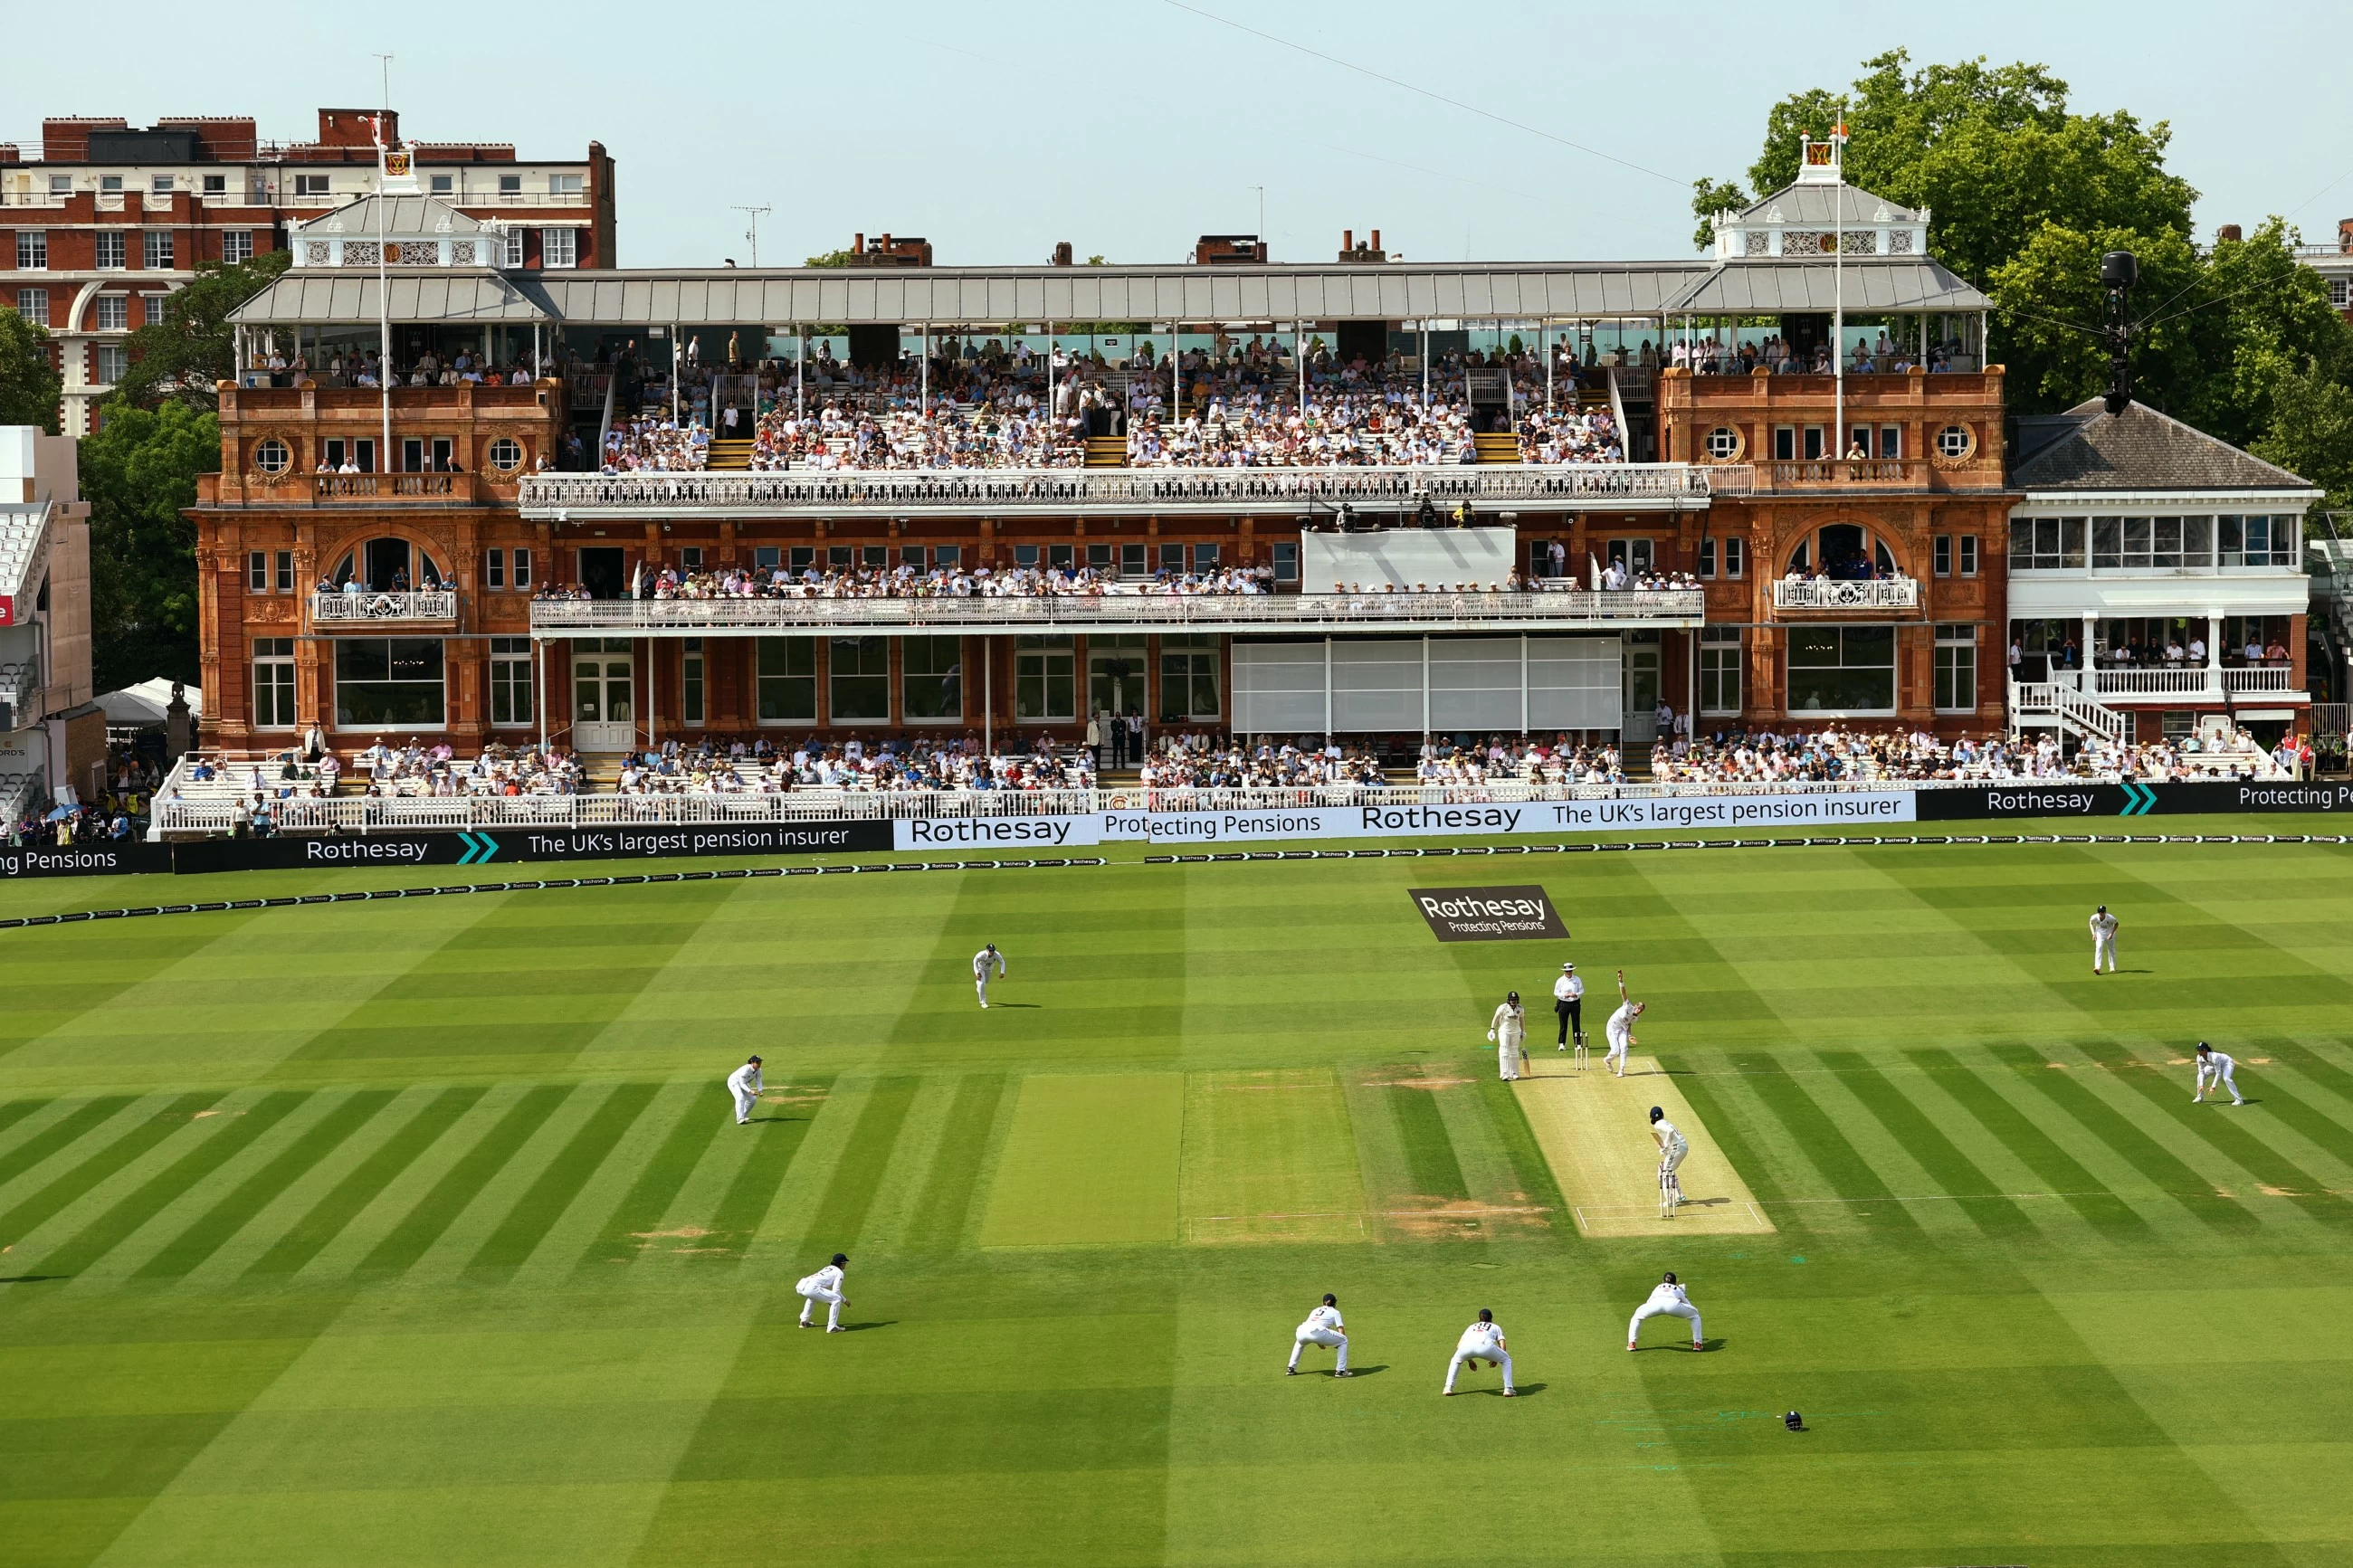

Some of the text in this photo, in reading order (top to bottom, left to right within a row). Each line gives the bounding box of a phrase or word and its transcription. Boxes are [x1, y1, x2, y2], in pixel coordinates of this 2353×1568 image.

[1988, 791, 2094, 813] Rothesay
[2240, 786, 2353, 809] Protecting P
[1363, 803, 1522, 832] Rothesay
[1552, 797, 1901, 825] The UK's largest pension insurer
[911, 818, 1072, 845] Rothesay
[1105, 811, 1321, 840] Protecting Pensions
[307, 840, 428, 863] Rothesay
[529, 827, 849, 854] The UK's largest pension insurer
[26, 850, 117, 870] Pensions
[1419, 896, 1545, 921] Rothesay
[1448, 919, 1546, 935] Protecting Pensions
